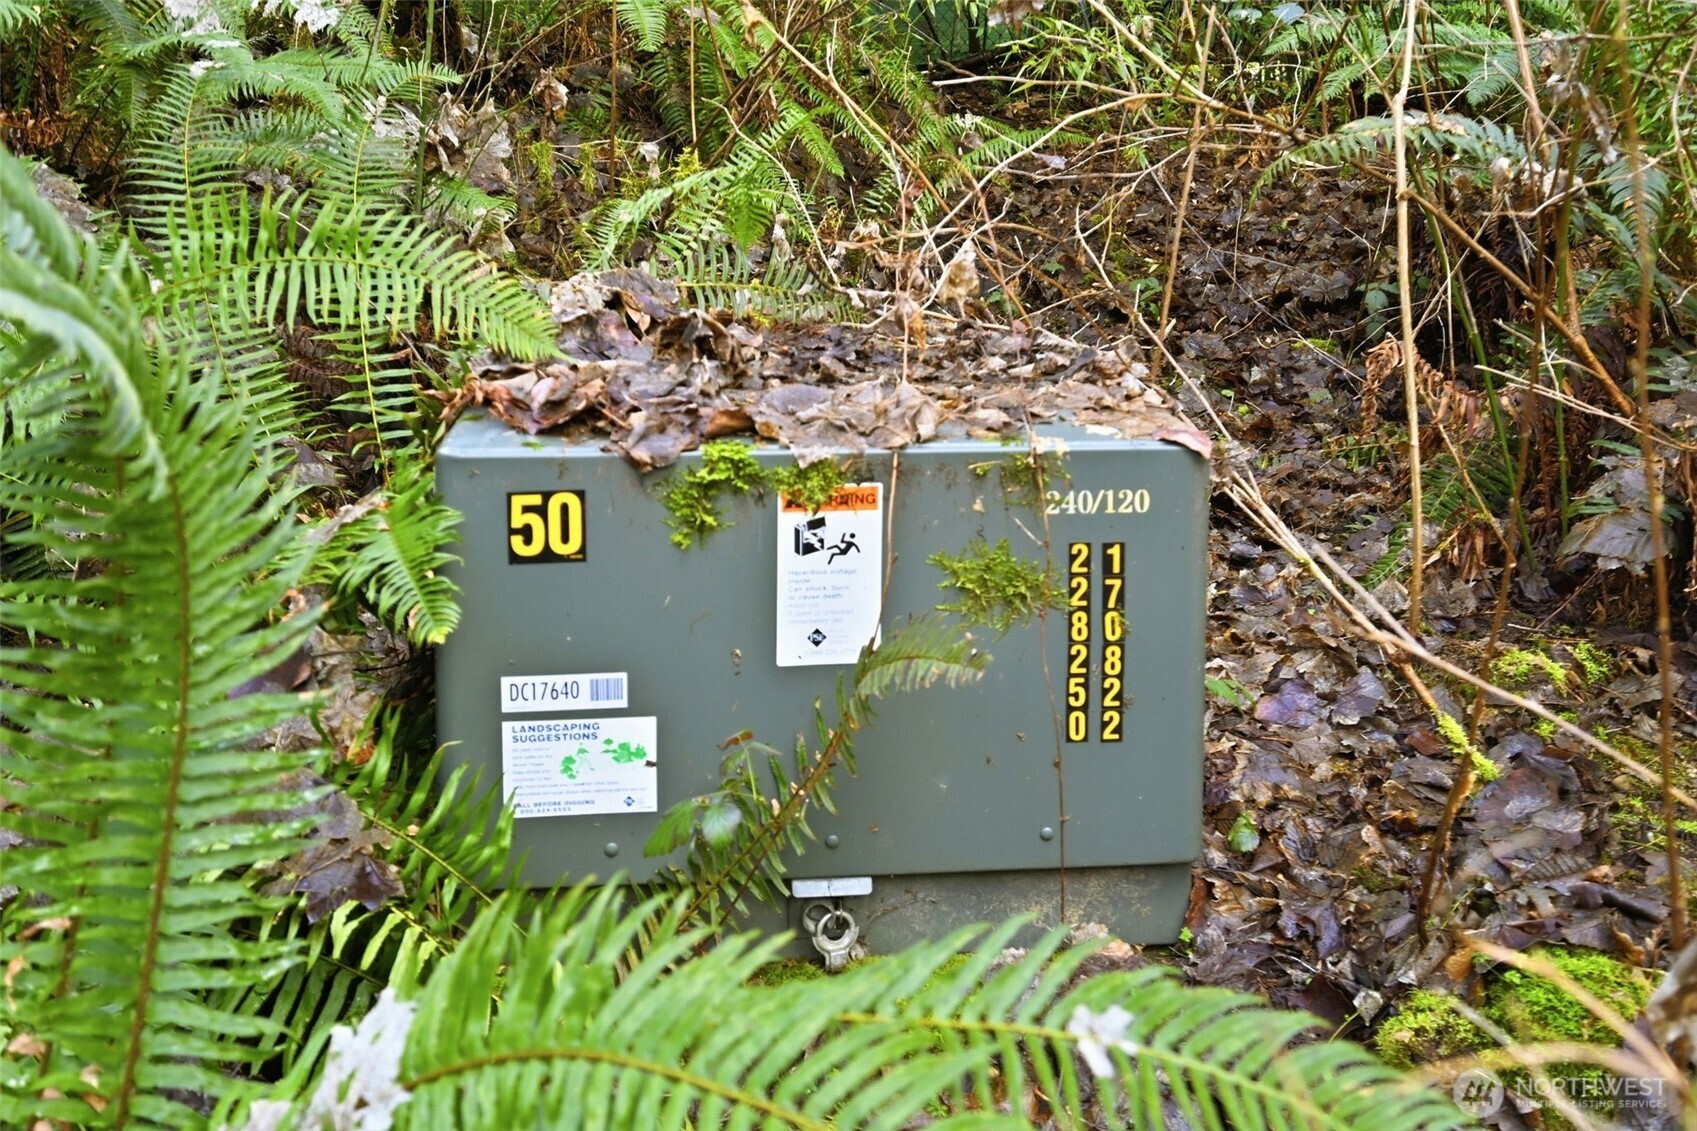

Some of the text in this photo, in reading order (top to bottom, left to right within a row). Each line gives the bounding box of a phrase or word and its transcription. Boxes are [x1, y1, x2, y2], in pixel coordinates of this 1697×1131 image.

[1045, 489, 1151, 515] 240/120
[510, 491, 582, 557] 50
[509, 680, 580, 702] DC17640
[511, 722, 600, 734] LANDSCAPING
[511, 732, 598, 743] SUGGESTIONS
